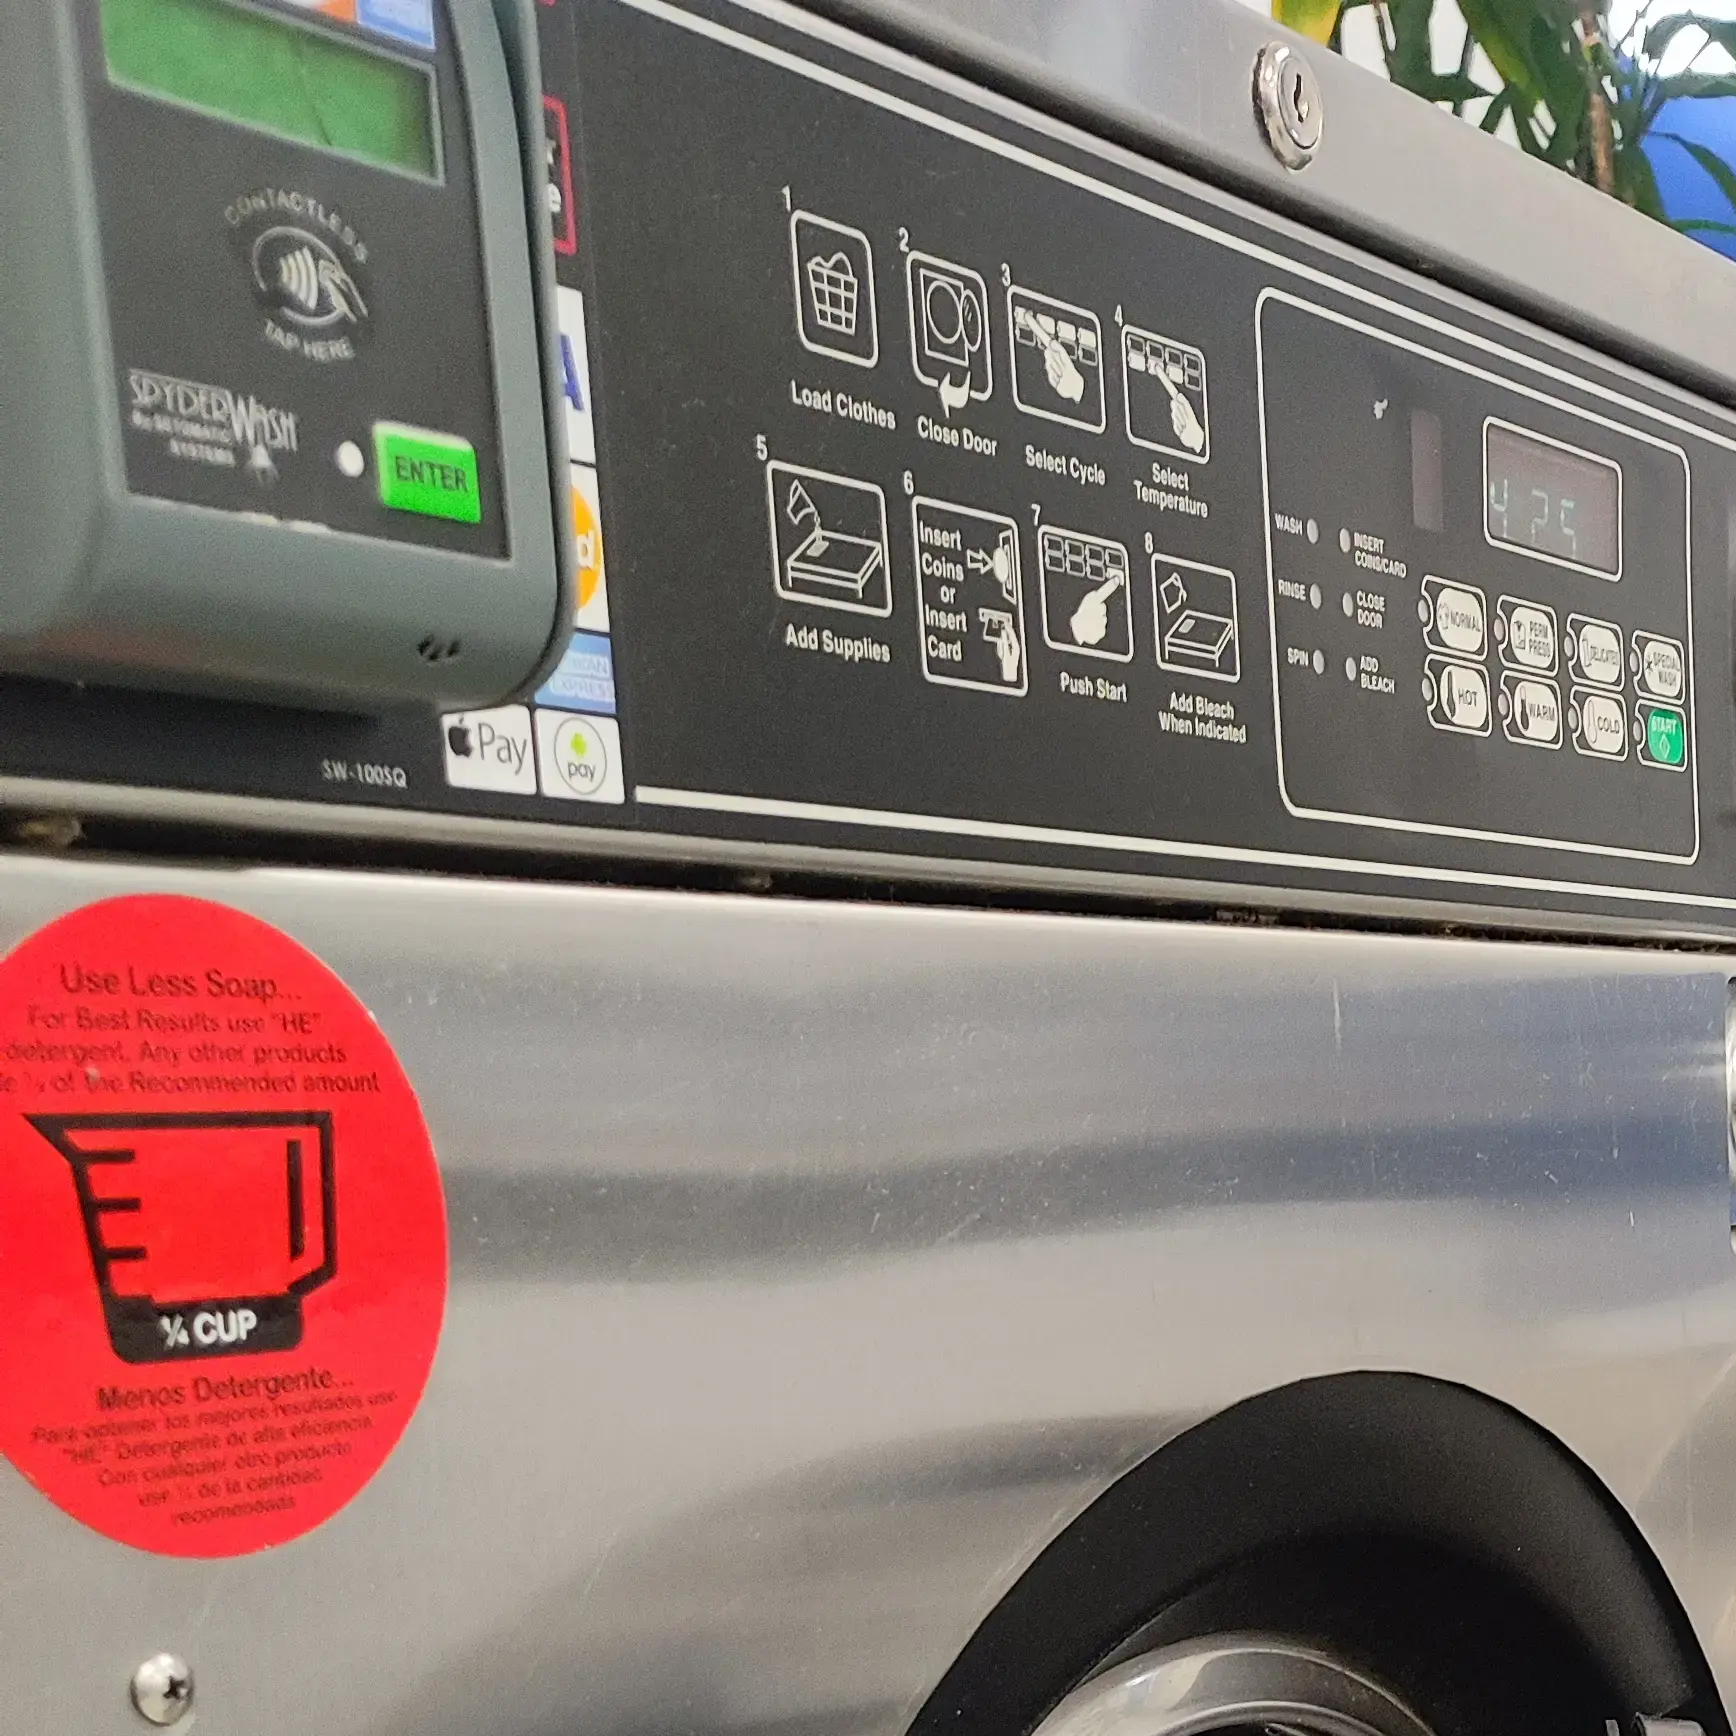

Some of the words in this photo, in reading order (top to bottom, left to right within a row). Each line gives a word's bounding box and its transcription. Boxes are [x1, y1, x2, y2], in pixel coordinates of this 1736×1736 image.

[782, 187, 792, 212] 1
[225, 189, 368, 264] CONTACTLESS
[898, 227, 909, 252] 2
[1001, 263, 1011, 287] 3
[1114, 305, 1123, 328] 4
[266, 319, 300, 349] TAP
[303, 337, 354, 362] HERE
[790, 380, 832, 413] Load
[836, 393, 896, 430] Clothes
[757, 433, 768, 461] 5
[917, 415, 959, 446] Close
[963, 422, 998, 457] Door
[395, 455, 468, 493] ENTER
[1025, 445, 1065, 476] Select
[1069, 455, 1105, 487] Cycle
[1152, 463, 1189, 490] Select
[903, 470, 913, 495] 6
[1134, 481, 1208, 518] Temperature
[1031, 504, 1040, 526] 7
[1274, 513, 1303, 536] WASH
[919, 521, 962, 550] Insert
[1145, 532, 1153, 554] 8
[1353, 532, 1384, 554] INSERT
[921, 553, 964, 581] Coins
[1354, 551, 1407, 579] COINS/CARD
[940, 584, 956, 603] or
[1278, 580, 1306, 601] RINSE
[1356, 591, 1385, 611] CLOSE
[925, 604, 967, 633] Insert
[1357, 609, 1383, 629] DOOR
[1450, 610, 1481, 632] NORMAL
[784, 623, 818, 652] Add
[822, 630, 891, 664] Supplies
[927, 632, 962, 662] Card
[1287, 647, 1309, 667] SPIN
[1360, 655, 1379, 673] ADD
[1060, 671, 1093, 697] Push
[1096, 676, 1128, 703] Start
[1360, 673, 1395, 694] BLEACH
[1169, 692, 1193, 714] Add
[1195, 696, 1235, 720] Bleach
[1458, 689, 1478, 708] HOT
[1529, 703, 1555, 721] WARM
[1597, 716, 1620, 734] COLD
[1158, 711, 1192, 737] When
[1194, 716, 1247, 744] Indicated
[1652, 715, 1677, 736] START
[477, 722, 527, 776] Pay
[322, 758, 408, 789] SW-100SQ
[567, 762, 596, 783] pay
[60, 962, 121, 995] Use
[128, 963, 198, 997] Less
[27, 1004, 66, 1029] For
[76, 1005, 129, 1030] Best
[137, 1007, 220, 1033] Results
[227, 1016, 265, 1033] use
[139, 1040, 180, 1067] Any
[189, 1042, 244, 1064] other
[253, 1041, 347, 1067] products
[128, 1070, 296, 1094] Recommended
[304, 1072, 380, 1094] amount
[193, 1308, 257, 1344] CUP
[97, 1385, 186, 1411] Menos
